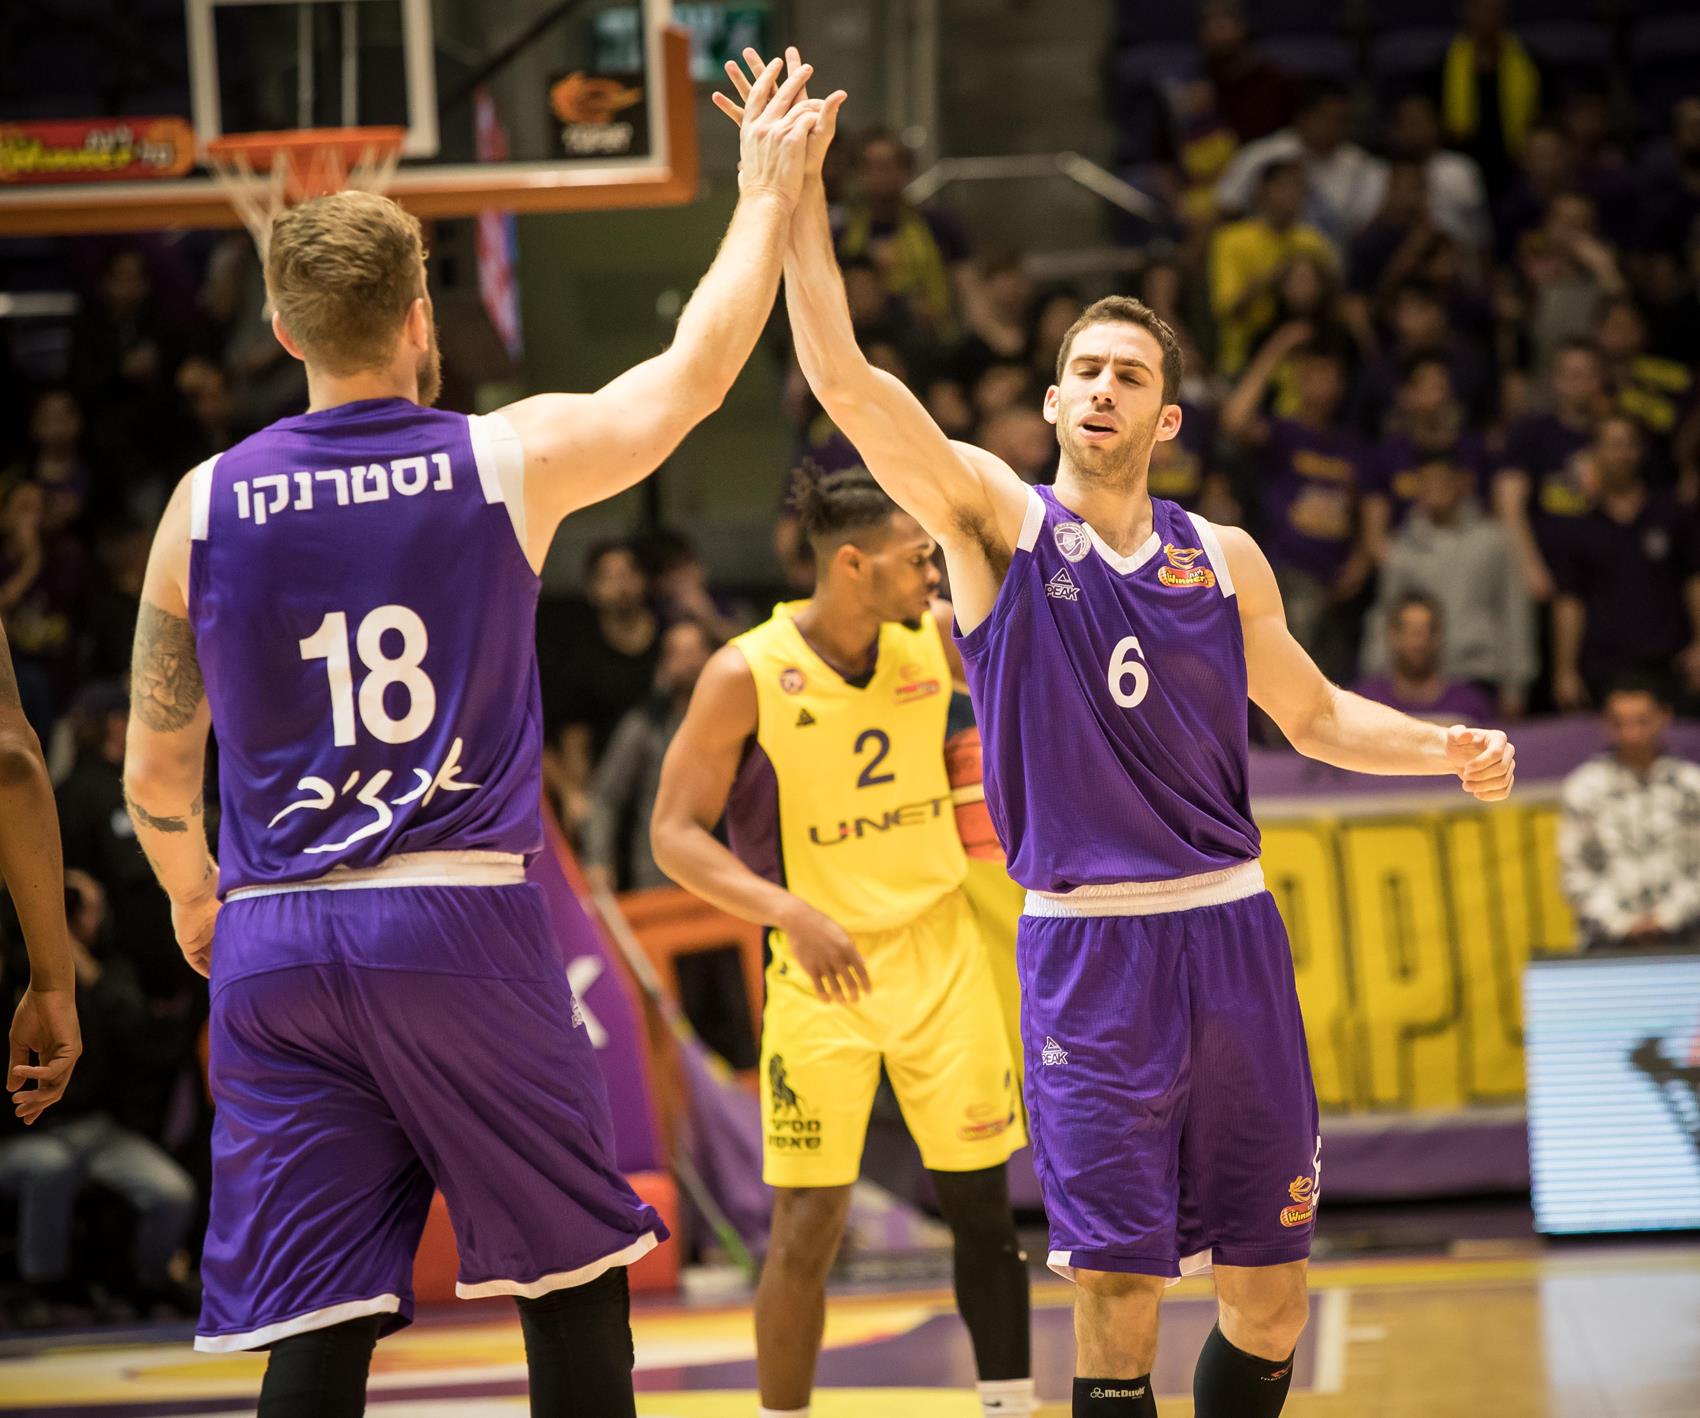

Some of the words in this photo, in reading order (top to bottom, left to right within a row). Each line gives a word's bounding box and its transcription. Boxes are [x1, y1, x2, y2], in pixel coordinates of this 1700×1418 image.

[233, 452, 454, 526] נסטרנקו
[1044, 583, 1081, 601] PEAK
[1166, 571, 1206, 586] Winner
[299, 604, 436, 747] 18
[1107, 635, 1150, 709] 6
[853, 728, 896, 789] 2
